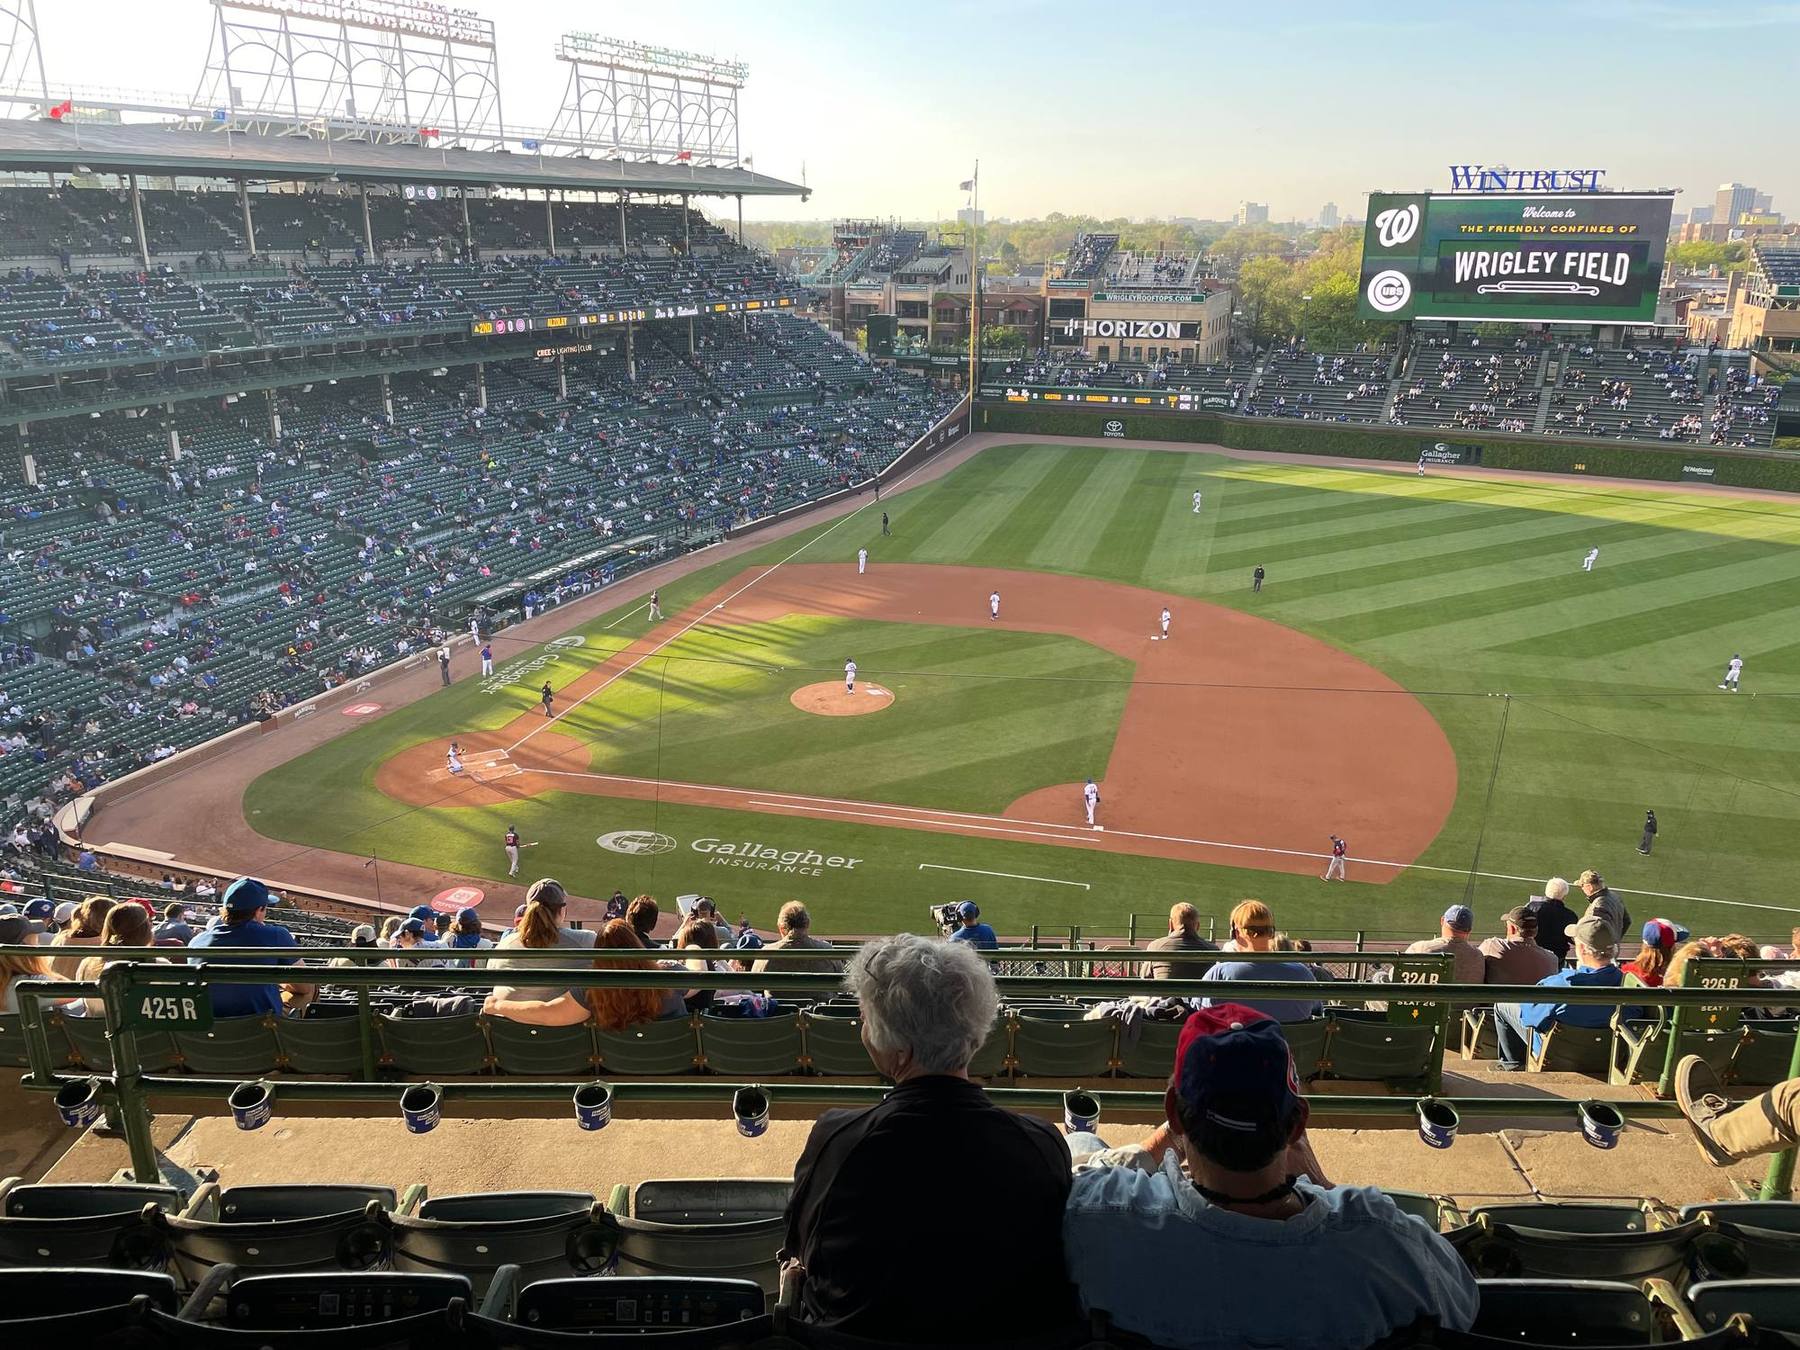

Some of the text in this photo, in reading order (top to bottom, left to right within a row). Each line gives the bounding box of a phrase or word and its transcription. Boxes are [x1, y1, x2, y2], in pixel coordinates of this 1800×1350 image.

[1449, 165, 1606, 191] WINTRUST
[1522, 206, 1576, 219] Welcome to
[1460, 225, 1483, 233] THE
[1488, 225, 1546, 233] FRIENDLY
[1550, 225, 1614, 233] CONFINES
[1455, 251, 1630, 286] WRIGLEY FIELD
[1083, 321, 1181, 339] HORIZON
[1421, 450, 1461, 459] Gallagher
[691, 838, 863, 869] Gallagher
[708, 857, 824, 877] INSURANCE
[141, 997, 198, 1020] 425 R
